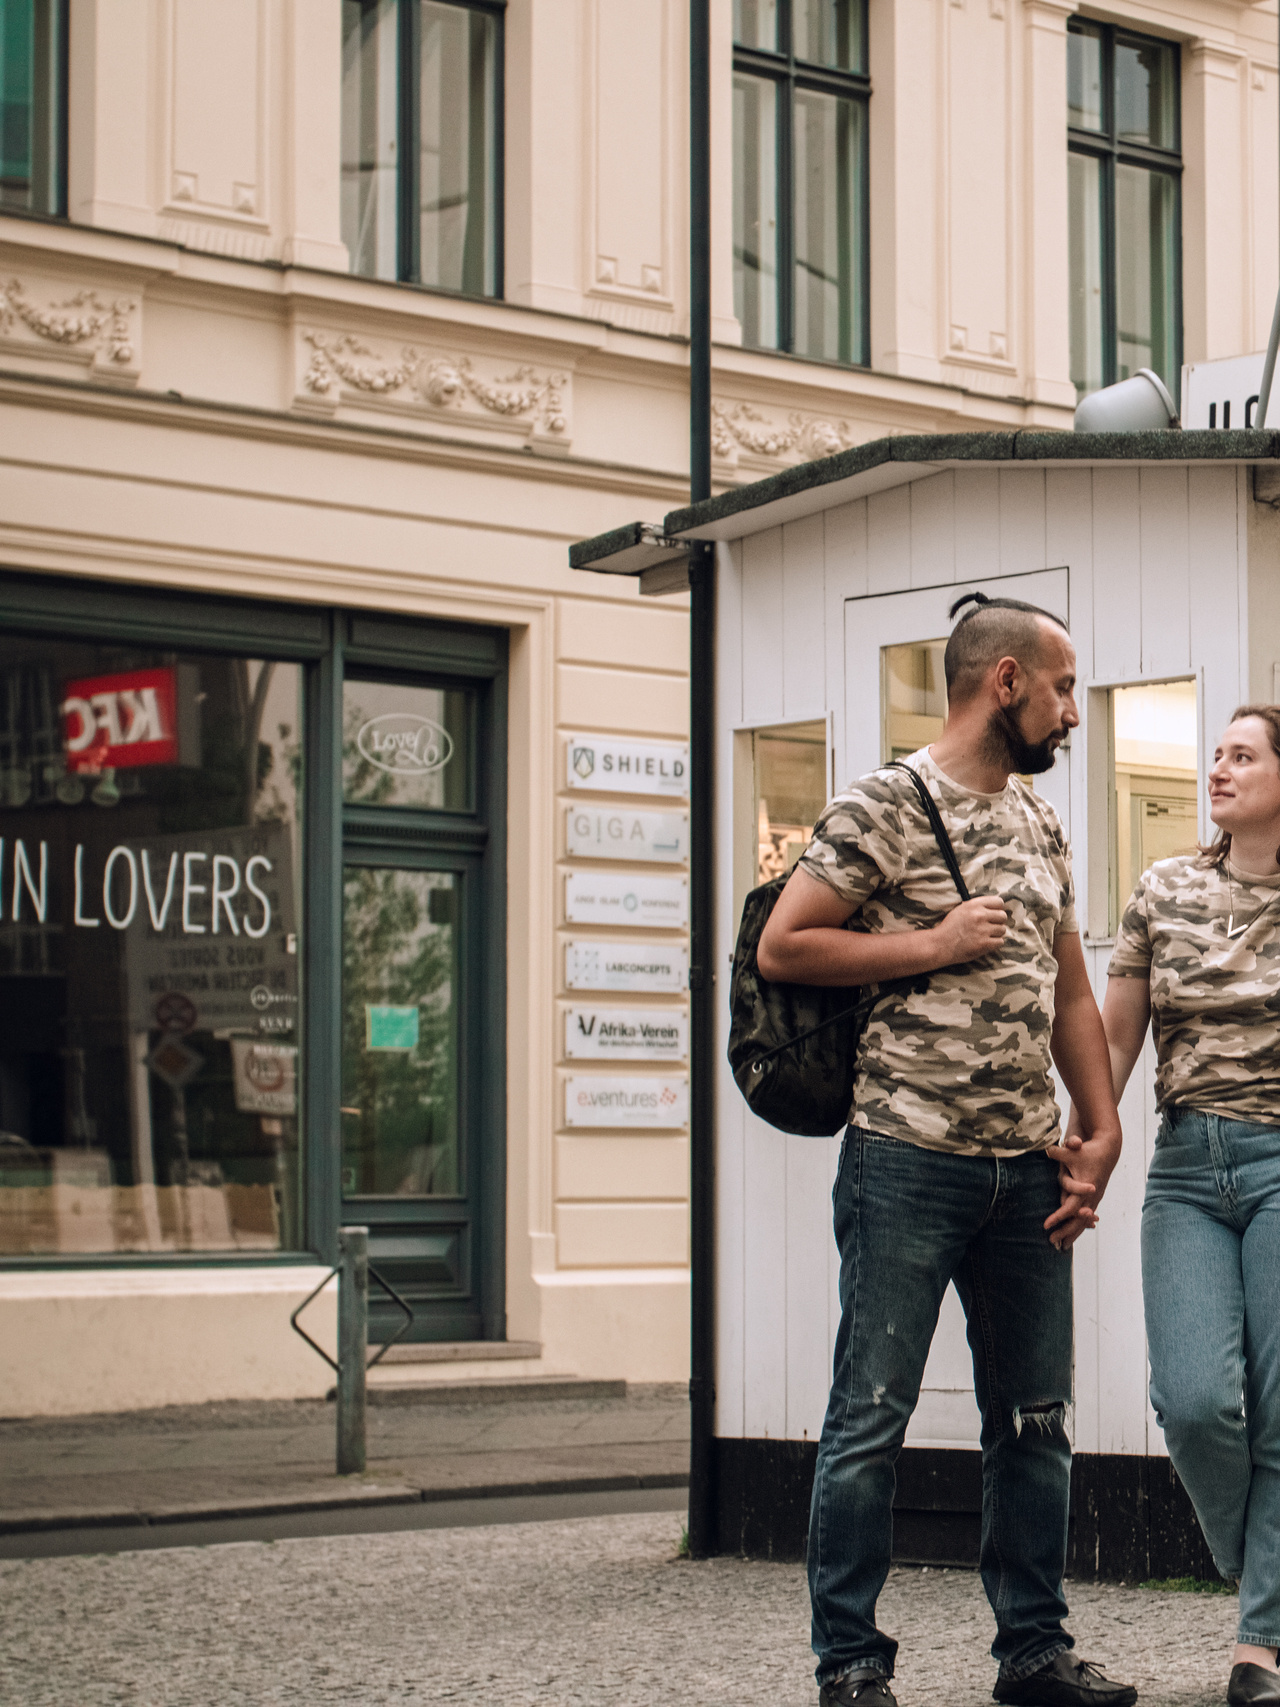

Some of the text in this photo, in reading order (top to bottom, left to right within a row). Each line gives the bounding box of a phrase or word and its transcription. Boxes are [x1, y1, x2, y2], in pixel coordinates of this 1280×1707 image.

[603, 753, 684, 778] SHIELD
[75, 844, 272, 939] LOVERS
[606, 963, 671, 975] LABCONCEPTS
[599, 1022, 679, 1039] Afrika-Verein
[577, 1089, 658, 1108] e.ventures
